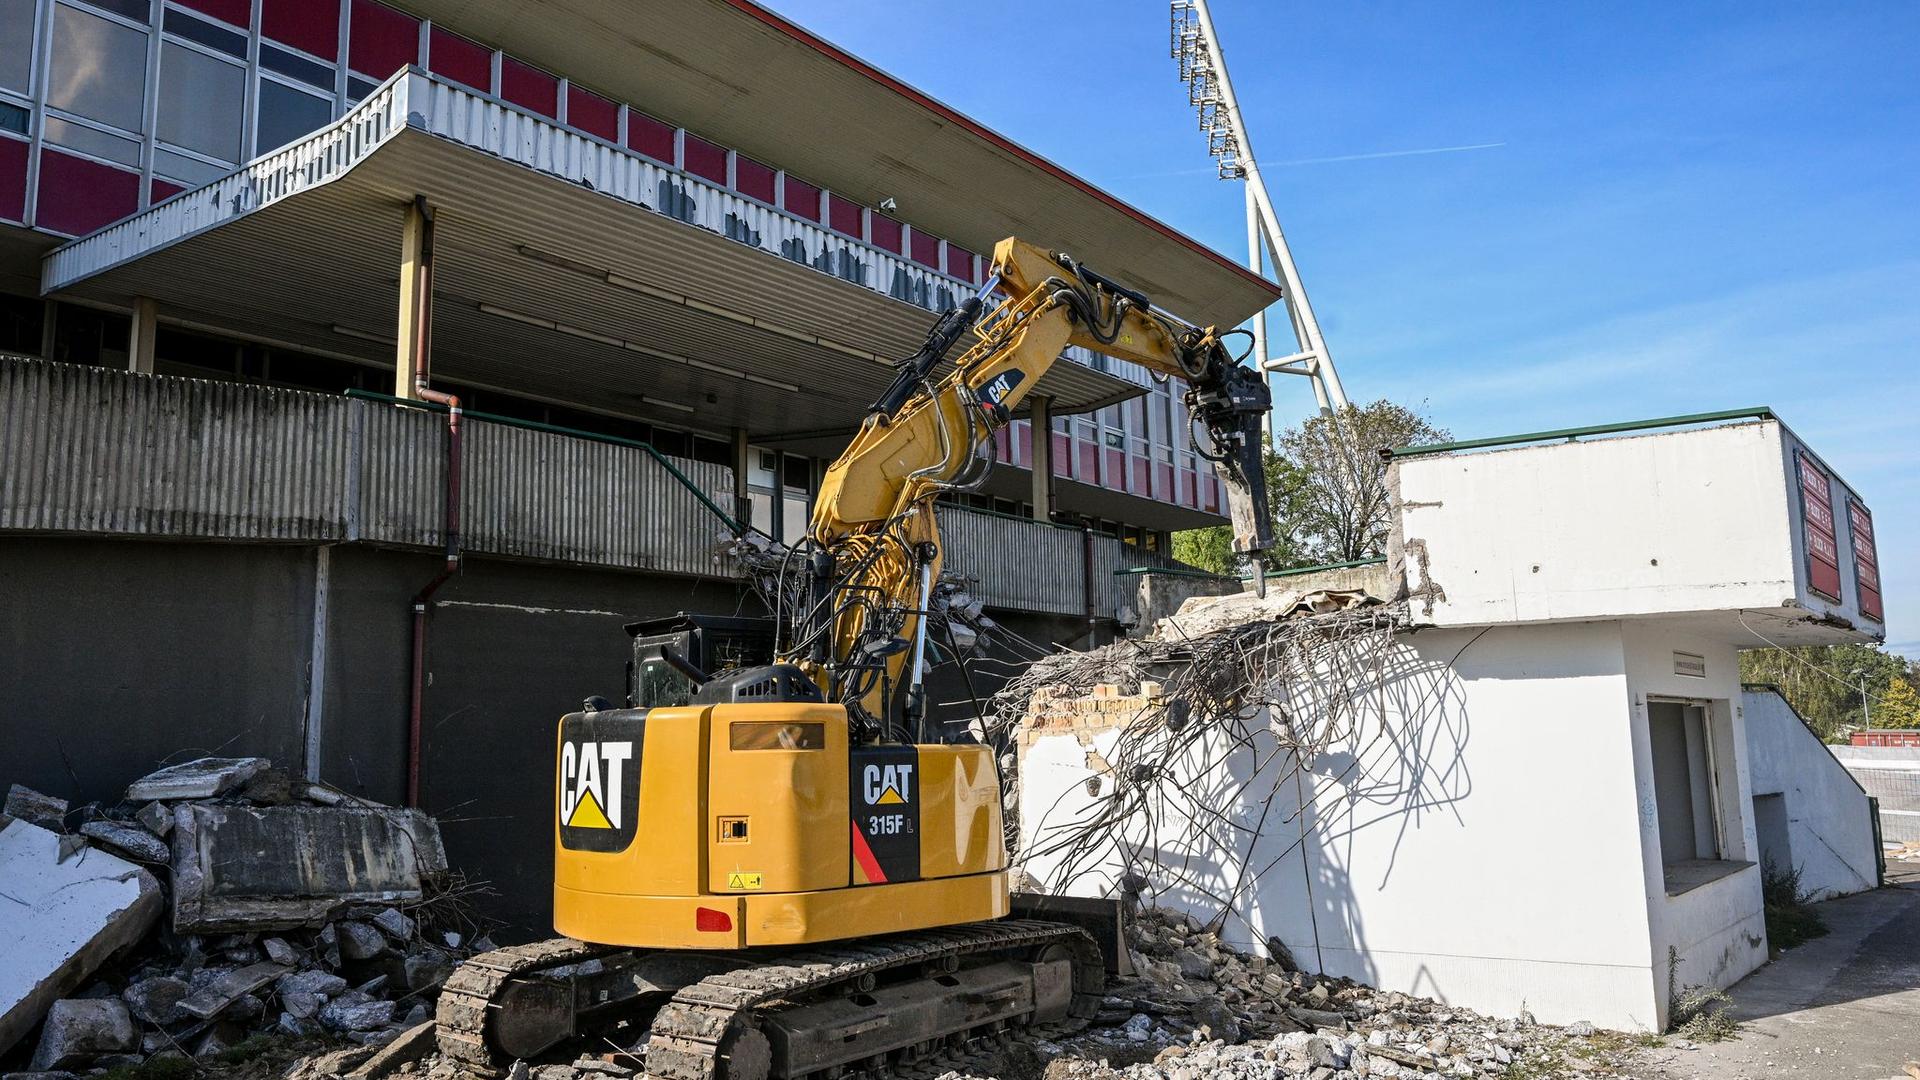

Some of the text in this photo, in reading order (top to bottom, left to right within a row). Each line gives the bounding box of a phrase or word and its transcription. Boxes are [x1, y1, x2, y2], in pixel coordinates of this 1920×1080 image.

[988, 374, 1011, 404] CAT
[561, 741, 633, 829] CAT
[864, 764, 912, 805] CAT
[869, 814, 904, 835] 315F
